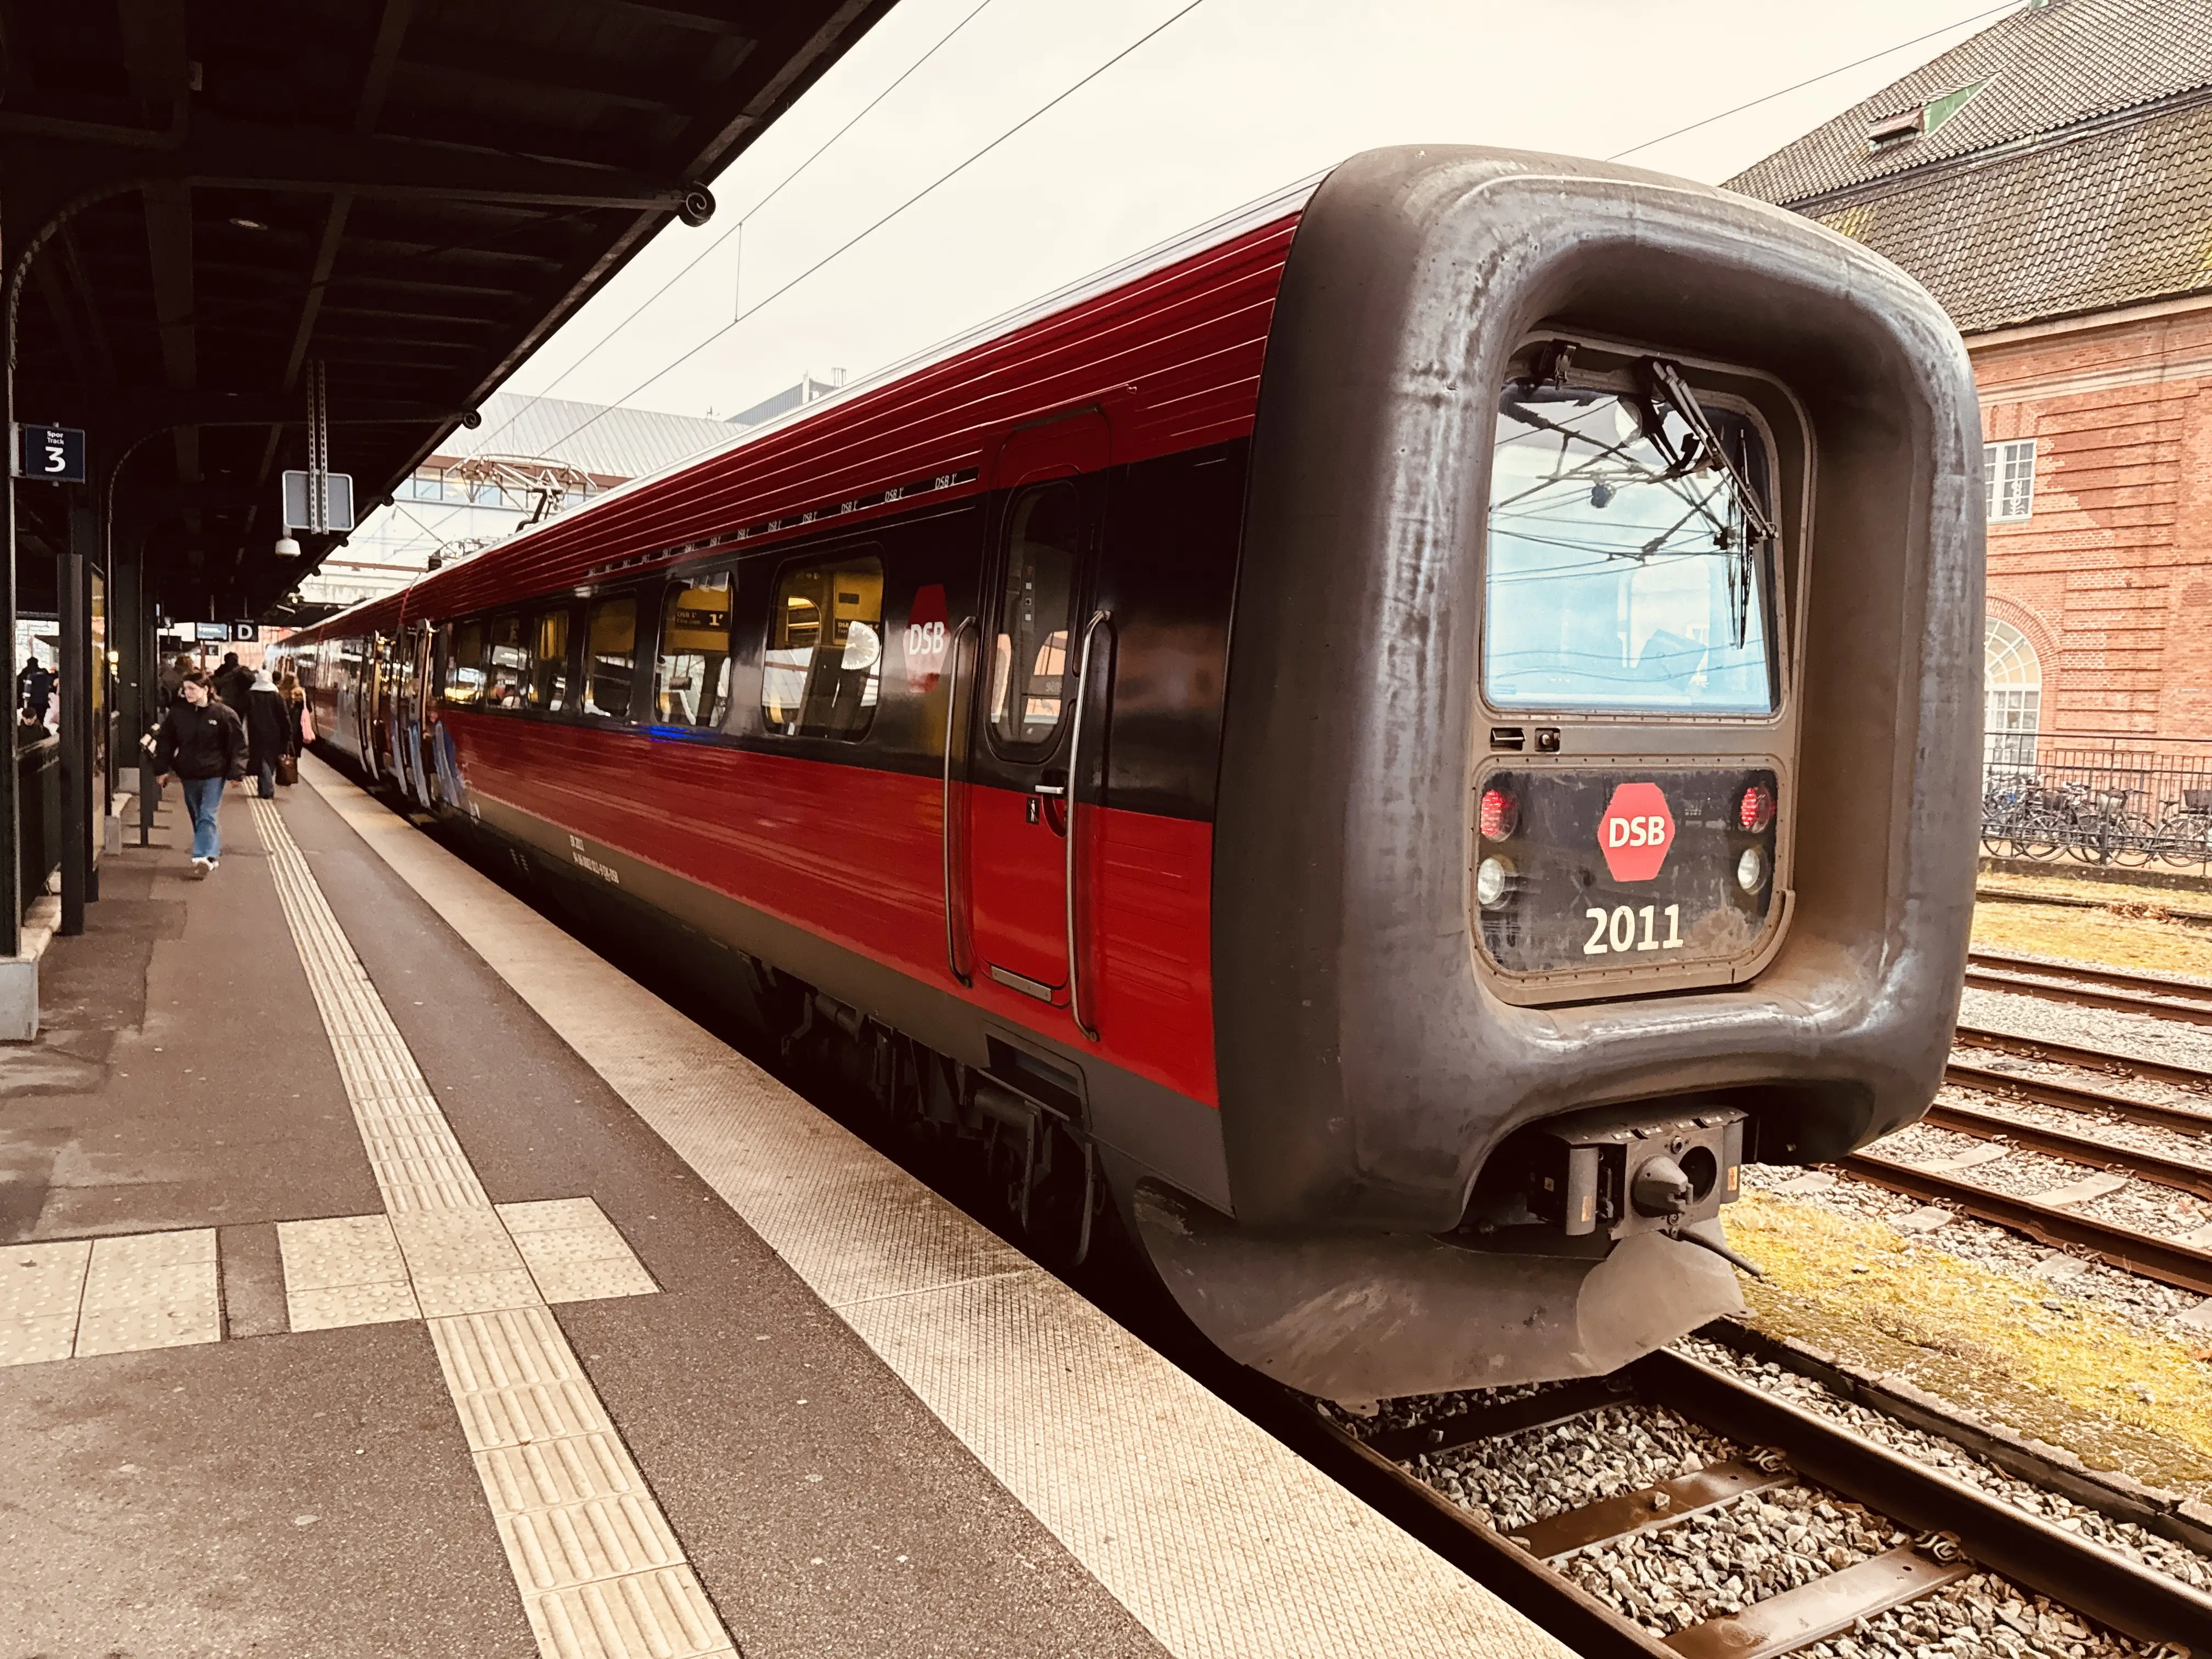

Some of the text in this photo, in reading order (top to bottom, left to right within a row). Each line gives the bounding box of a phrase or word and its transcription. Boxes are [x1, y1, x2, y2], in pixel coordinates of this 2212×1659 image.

[45, 446, 66, 472] 3
[935, 476, 949, 489] DSB
[884, 490, 898, 501] DSB
[841, 503, 851, 514] DSB
[802, 512, 812, 523] DSB
[238, 624, 252, 640] D
[910, 621, 944, 654] DSB
[1609, 816, 1665, 848] DSB
[1583, 904, 1684, 955] 2011
